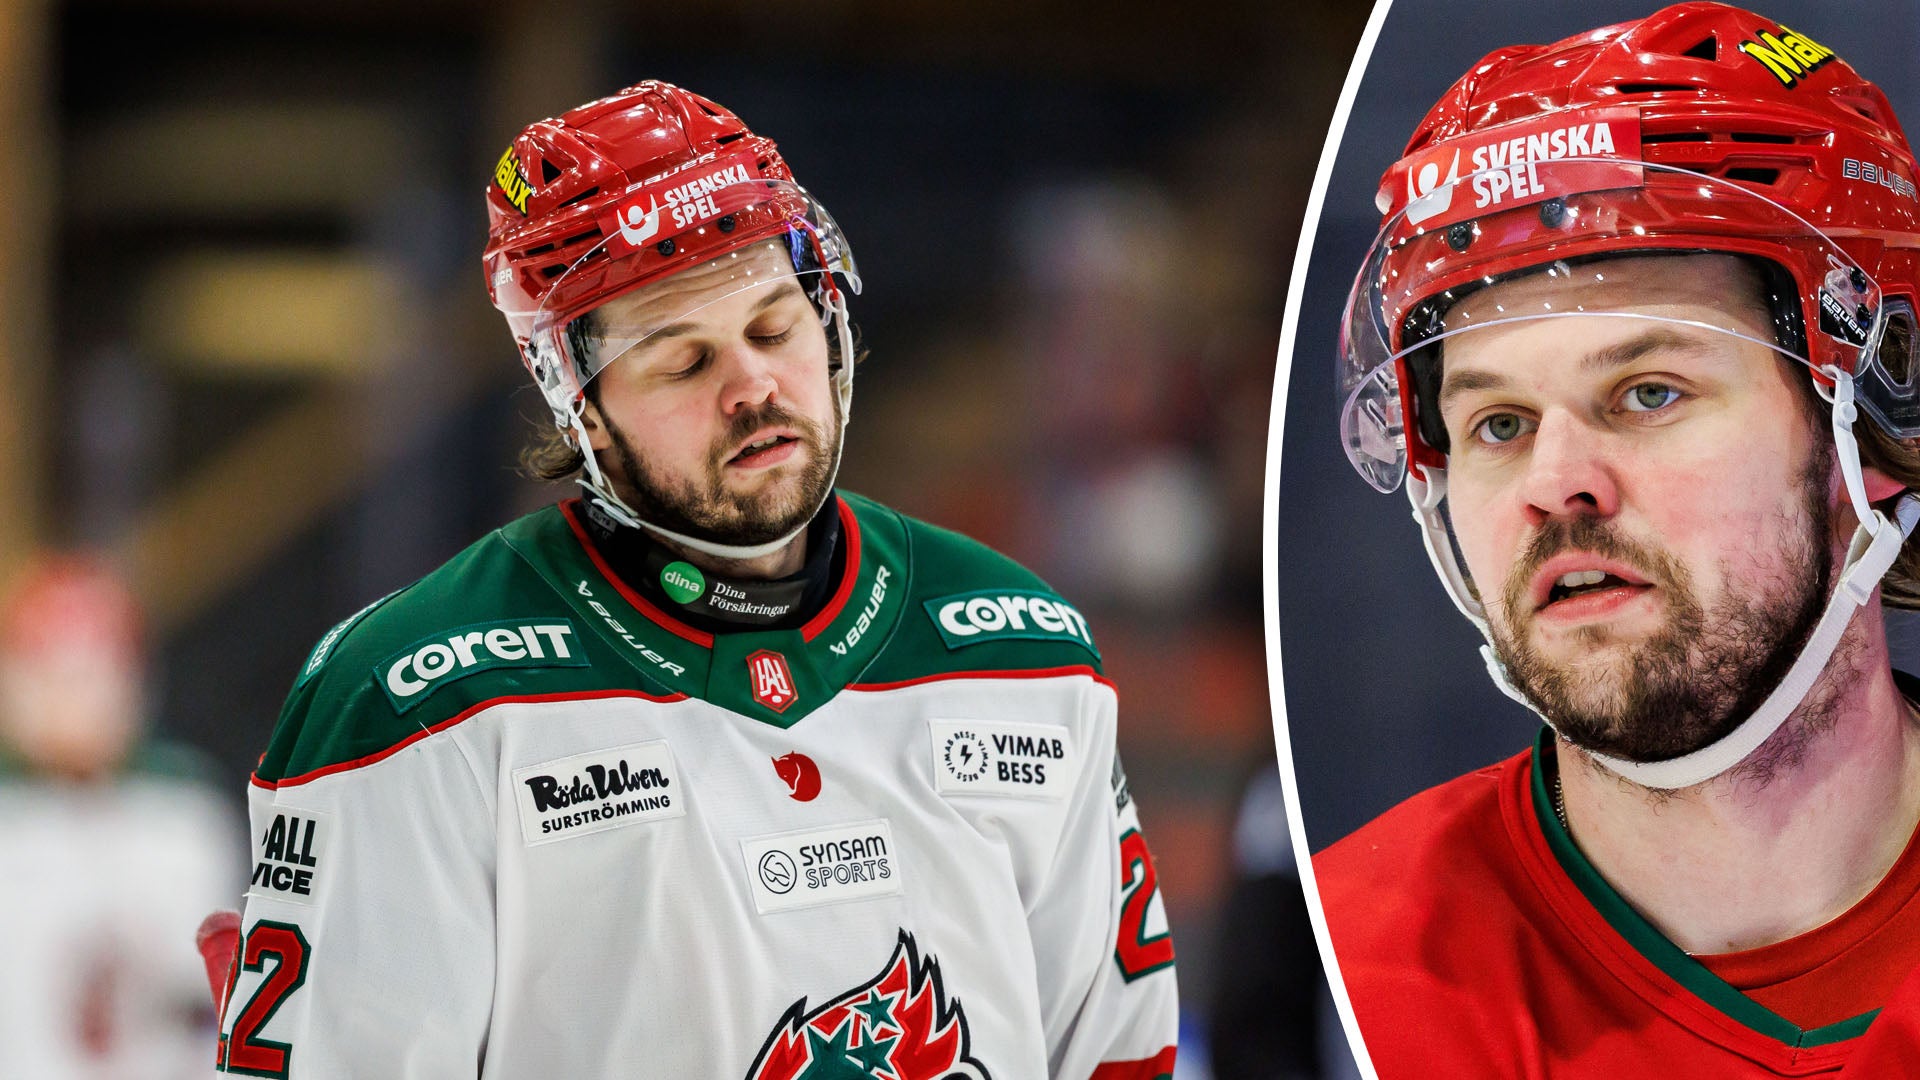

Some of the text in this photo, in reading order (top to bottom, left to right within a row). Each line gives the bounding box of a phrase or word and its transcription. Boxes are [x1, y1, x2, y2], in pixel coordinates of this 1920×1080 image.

[1744, 24, 1835, 84] Mal
[1472, 122, 1616, 174] SVENSKA
[664, 164, 750, 208] SVENSKA
[1472, 162, 1545, 209] SPEL
[1843, 158, 1919, 203] BAUER
[671, 195, 721, 229] SPEL
[1822, 293, 1867, 340] BAUER
[664, 571, 701, 593] dina
[714, 582, 746, 599] Dina
[708, 594, 789, 617] Försäkringar
[991, 733, 1064, 760] VIMAB
[997, 761, 1046, 785] BESS
[525, 775, 596, 812] Röda
[542, 795, 671, 834] SURSTRÖMMING
[262, 814, 317, 868] ALL
[799, 836, 887, 867] SYNSAM
[805, 858, 891, 889] SPORTS
